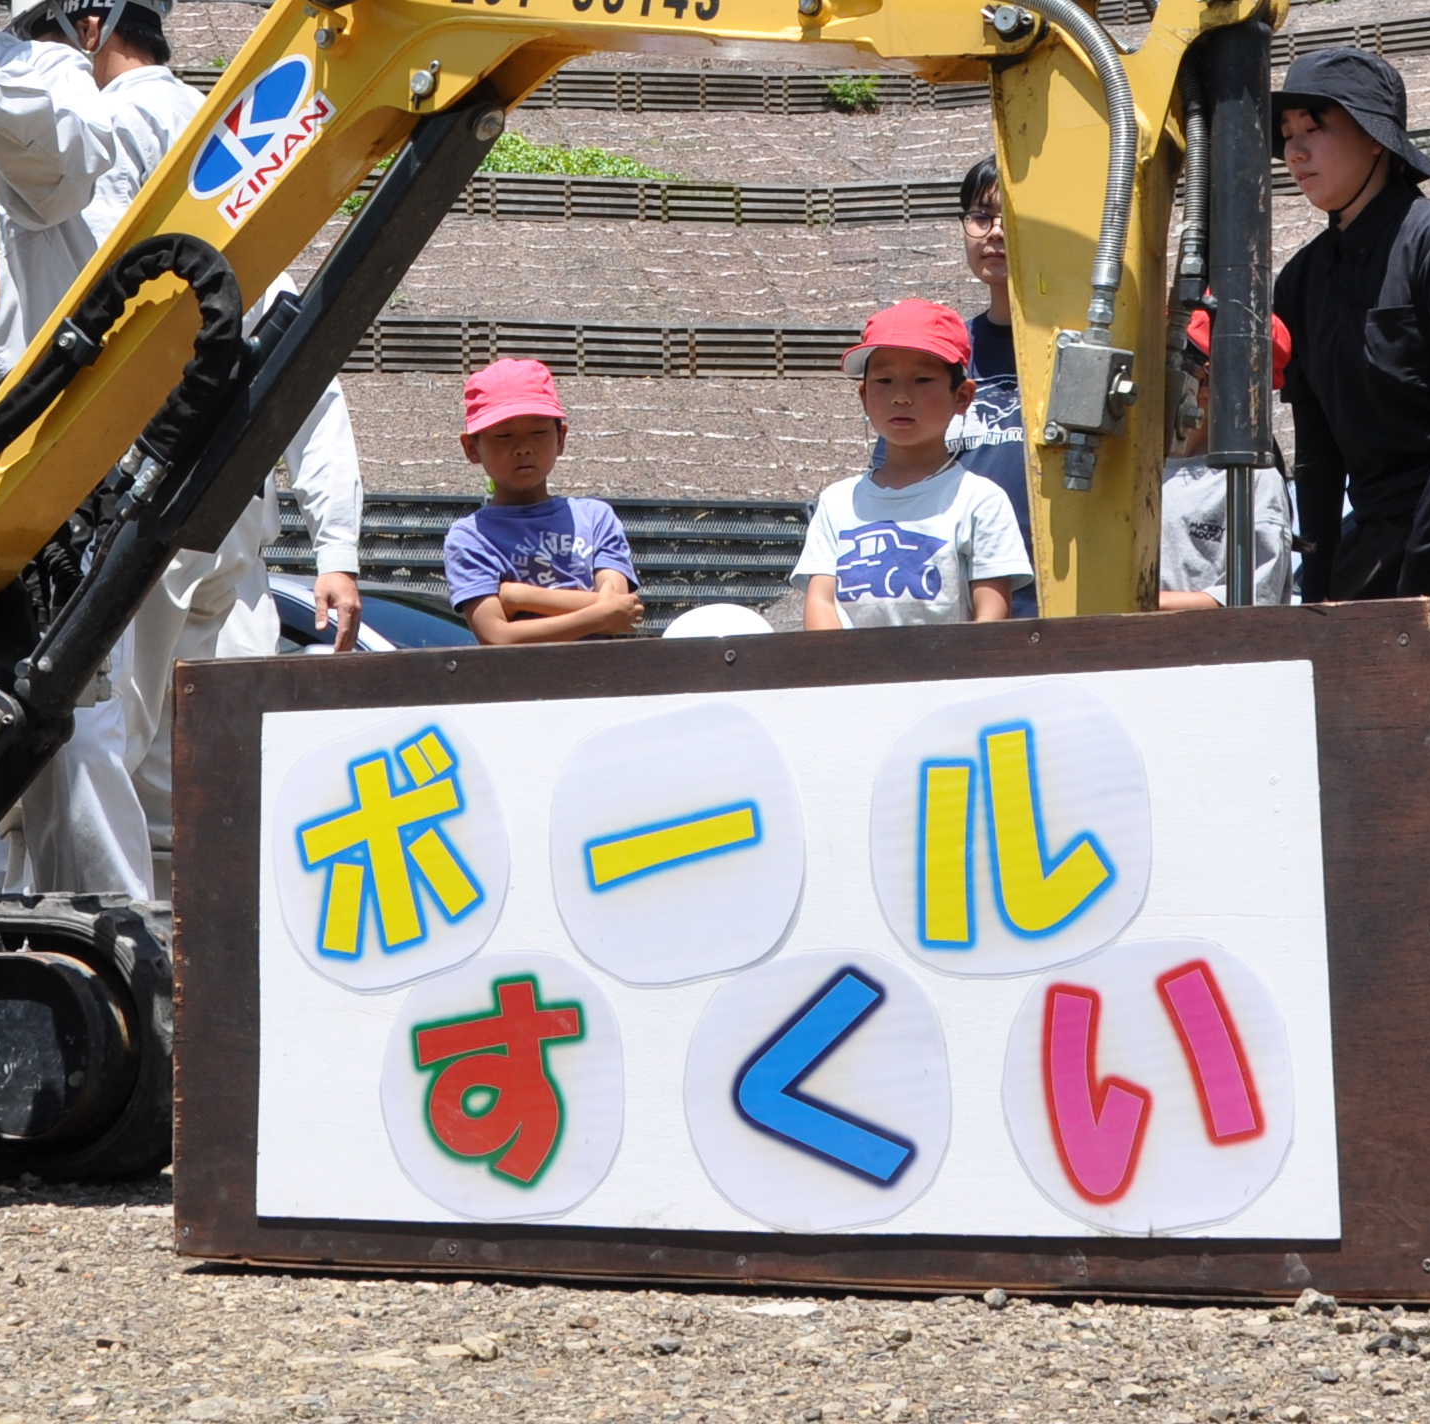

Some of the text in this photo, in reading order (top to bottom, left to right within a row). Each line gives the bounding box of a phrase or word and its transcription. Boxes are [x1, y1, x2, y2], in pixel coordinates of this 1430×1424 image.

[224, 98, 330, 221] KINAN
[295, 720, 1118, 962] ボール
[410, 960, 1267, 1205] すくい
